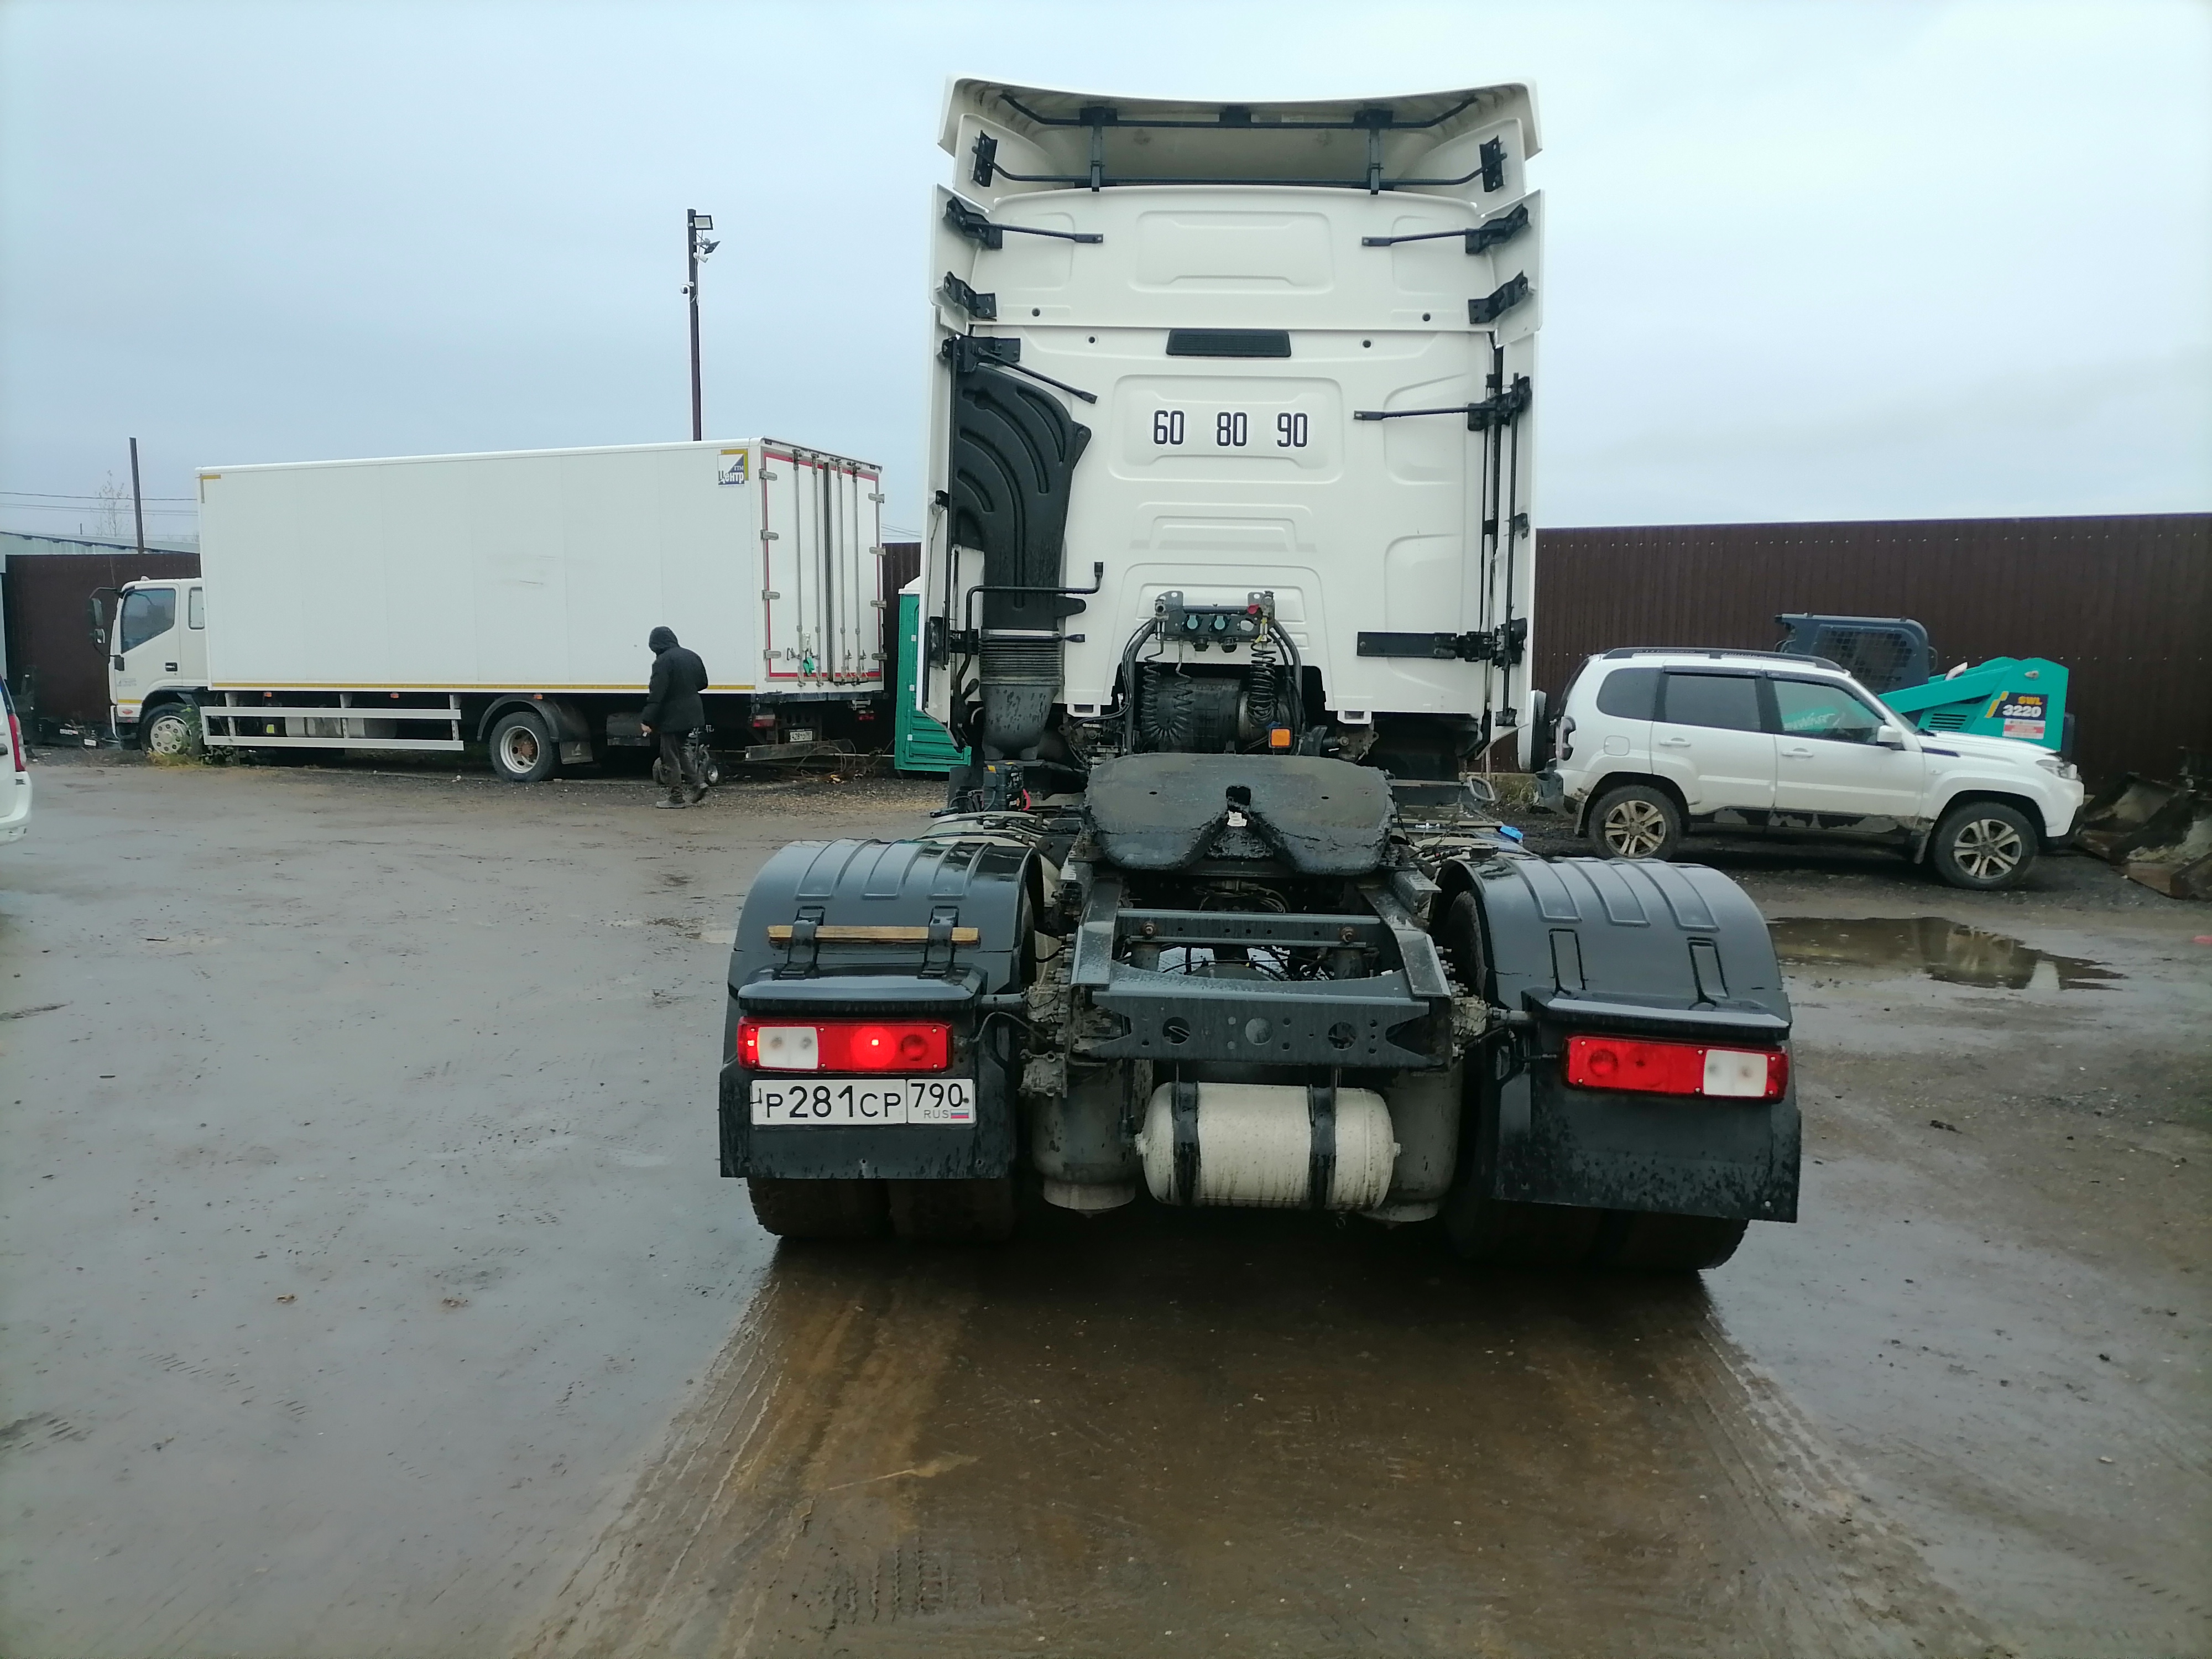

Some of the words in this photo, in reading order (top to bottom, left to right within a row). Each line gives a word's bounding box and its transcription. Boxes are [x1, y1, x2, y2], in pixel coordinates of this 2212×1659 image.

[1154, 410, 1185, 445] 60
[1217, 412, 1247, 446] 80
[1277, 413, 1307, 447] 90
[718, 471, 744, 484] Центр
[2002, 705, 2042, 717] 3220
[911, 1083, 963, 1108] 790
[924, 1110, 950, 1119] RUS
